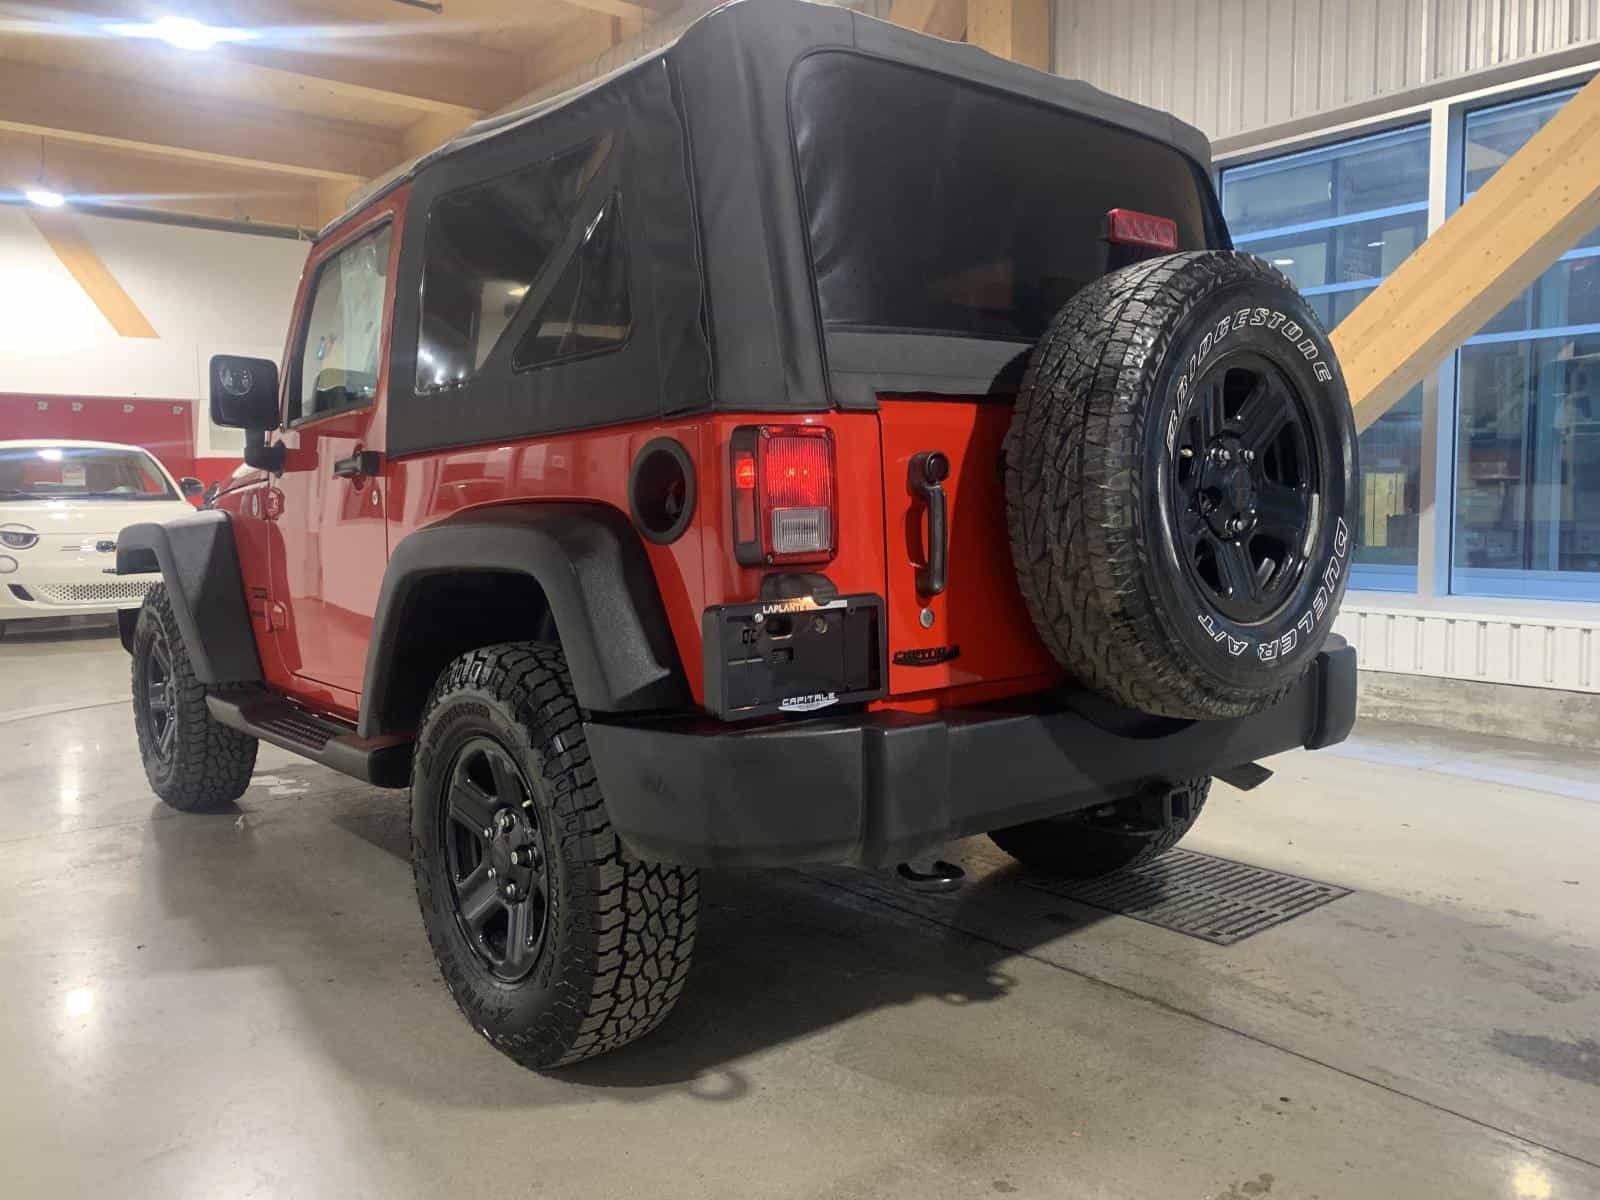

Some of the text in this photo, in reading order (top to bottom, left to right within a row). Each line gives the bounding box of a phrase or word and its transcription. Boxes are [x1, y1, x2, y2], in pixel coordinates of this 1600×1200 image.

[1167, 307, 1332, 462] BRIDGESTONE
[1198, 516, 1348, 662] DUELER A/T
